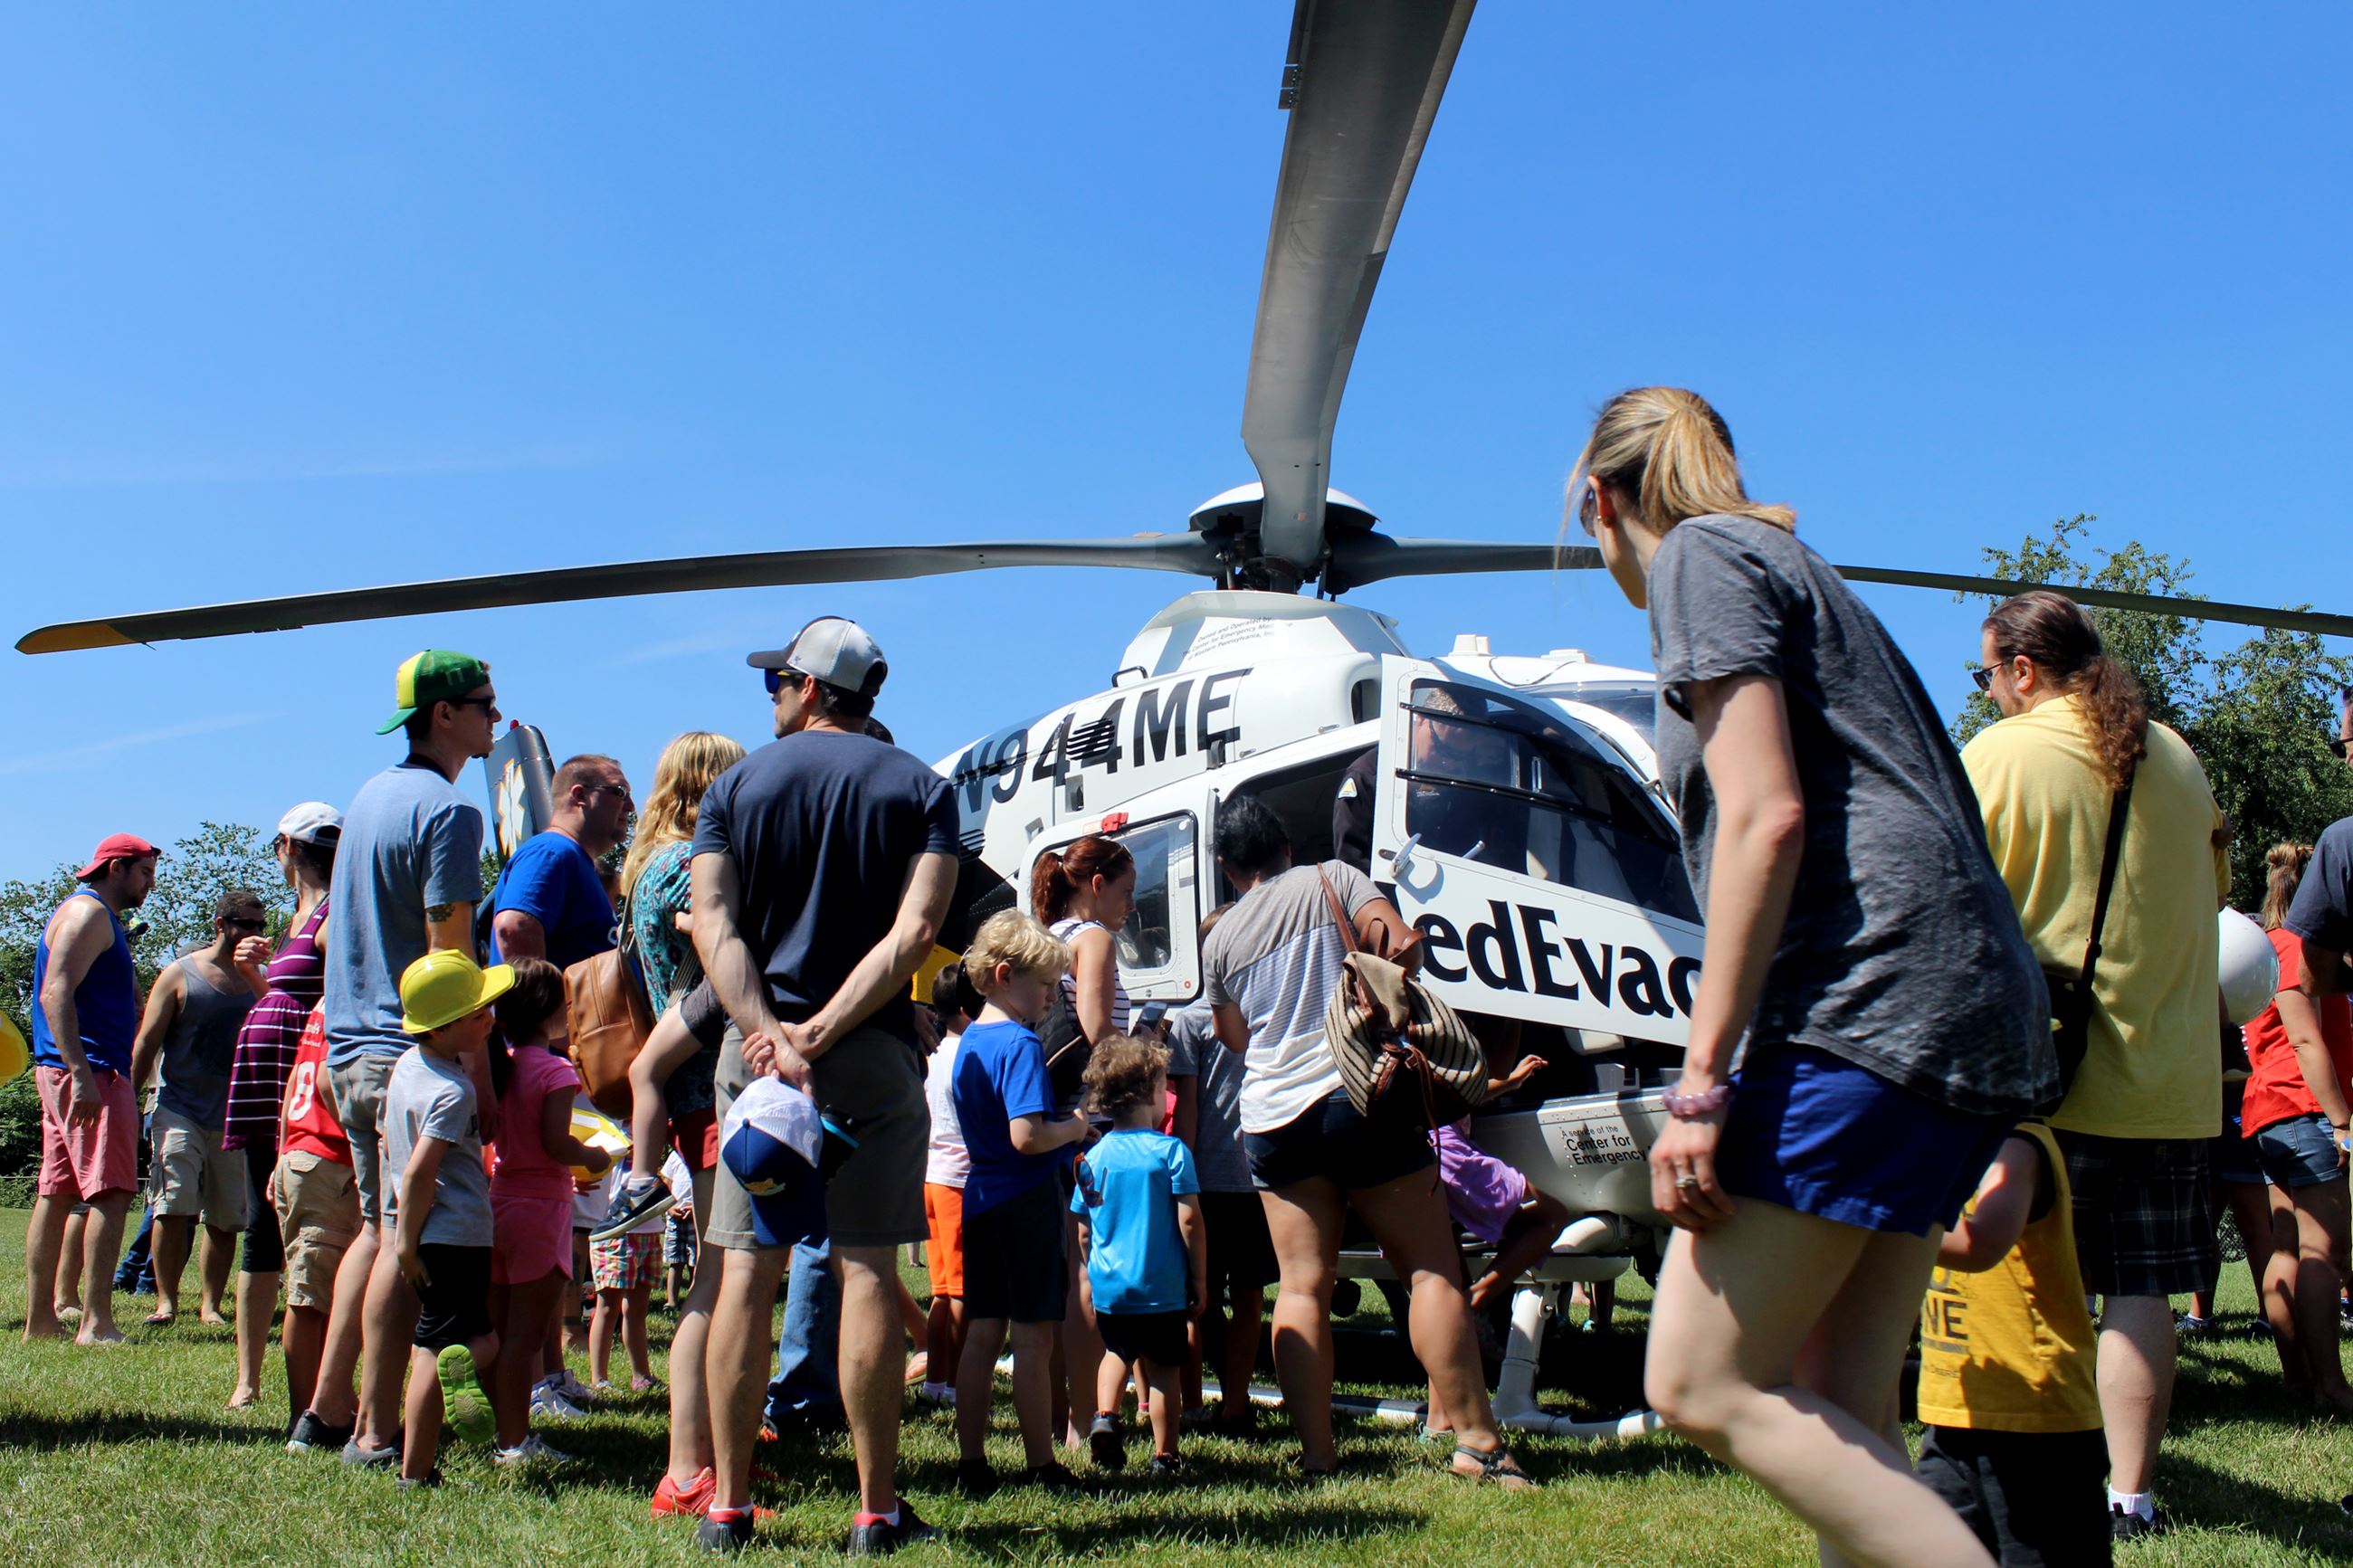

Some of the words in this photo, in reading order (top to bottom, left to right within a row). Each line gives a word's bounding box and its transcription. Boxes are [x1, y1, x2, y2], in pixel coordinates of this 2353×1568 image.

[1218, 625, 1229, 635] and
[1230, 616, 1262, 630] Operated
[1220, 626, 1256, 641] Emergency
[952, 668, 1254, 813] N944ME
[1374, 880, 1702, 1020] edEvac
[1568, 1128, 1596, 1137] service
[1596, 1126, 1605, 1134] of
[1605, 1124, 1619, 1134] the
[1566, 1138, 1608, 1152] Center
[1612, 1134, 1632, 1147] for
[1572, 1148, 1647, 1165] Emergency
